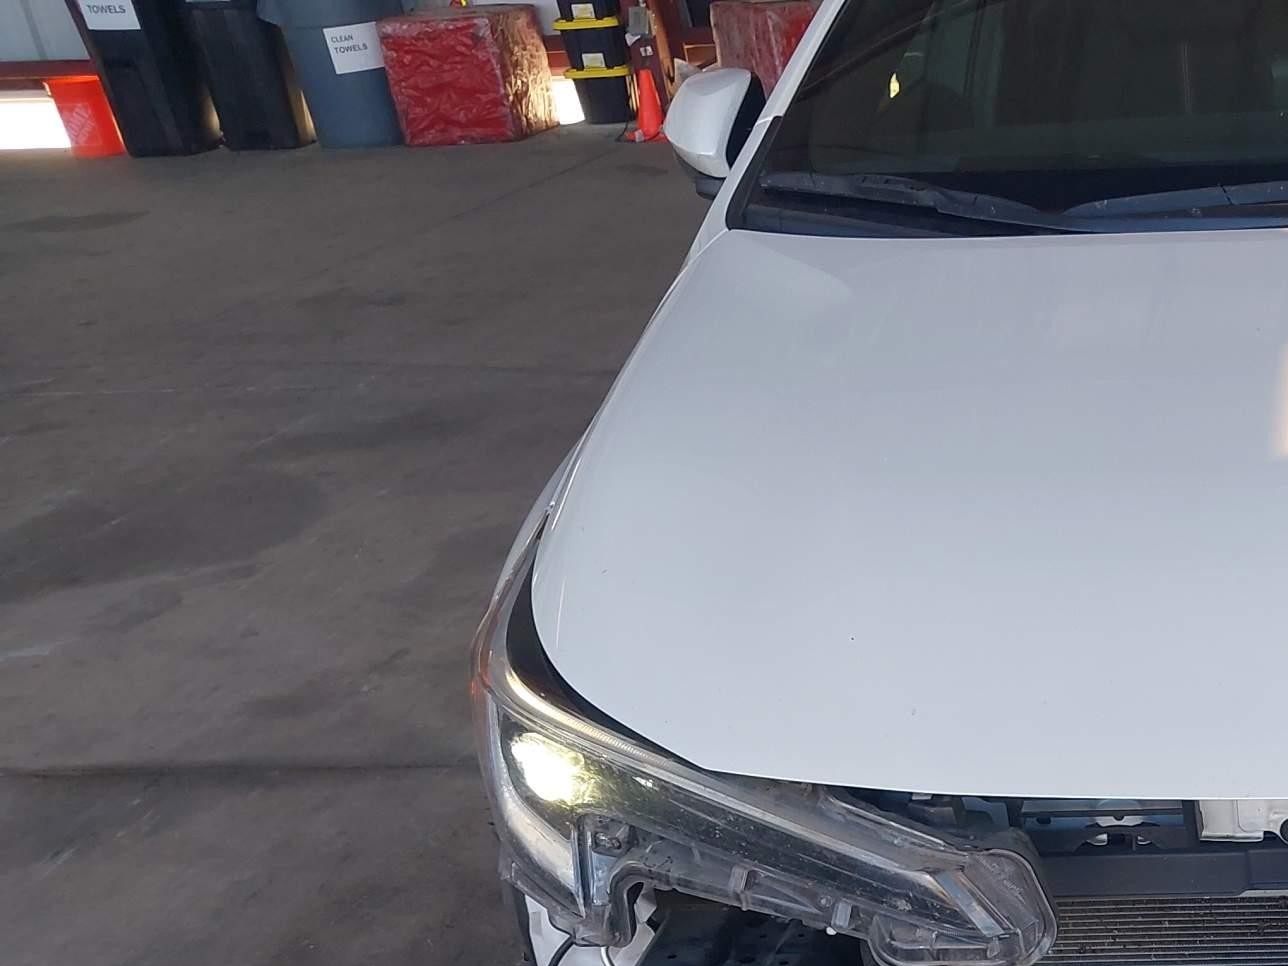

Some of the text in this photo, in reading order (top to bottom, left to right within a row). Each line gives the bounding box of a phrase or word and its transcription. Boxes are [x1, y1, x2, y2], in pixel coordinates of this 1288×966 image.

[86, 4, 126, 14] TOWELS
[330, 34, 354, 44] CLEAN
[334, 42, 368, 54] TOWELS
